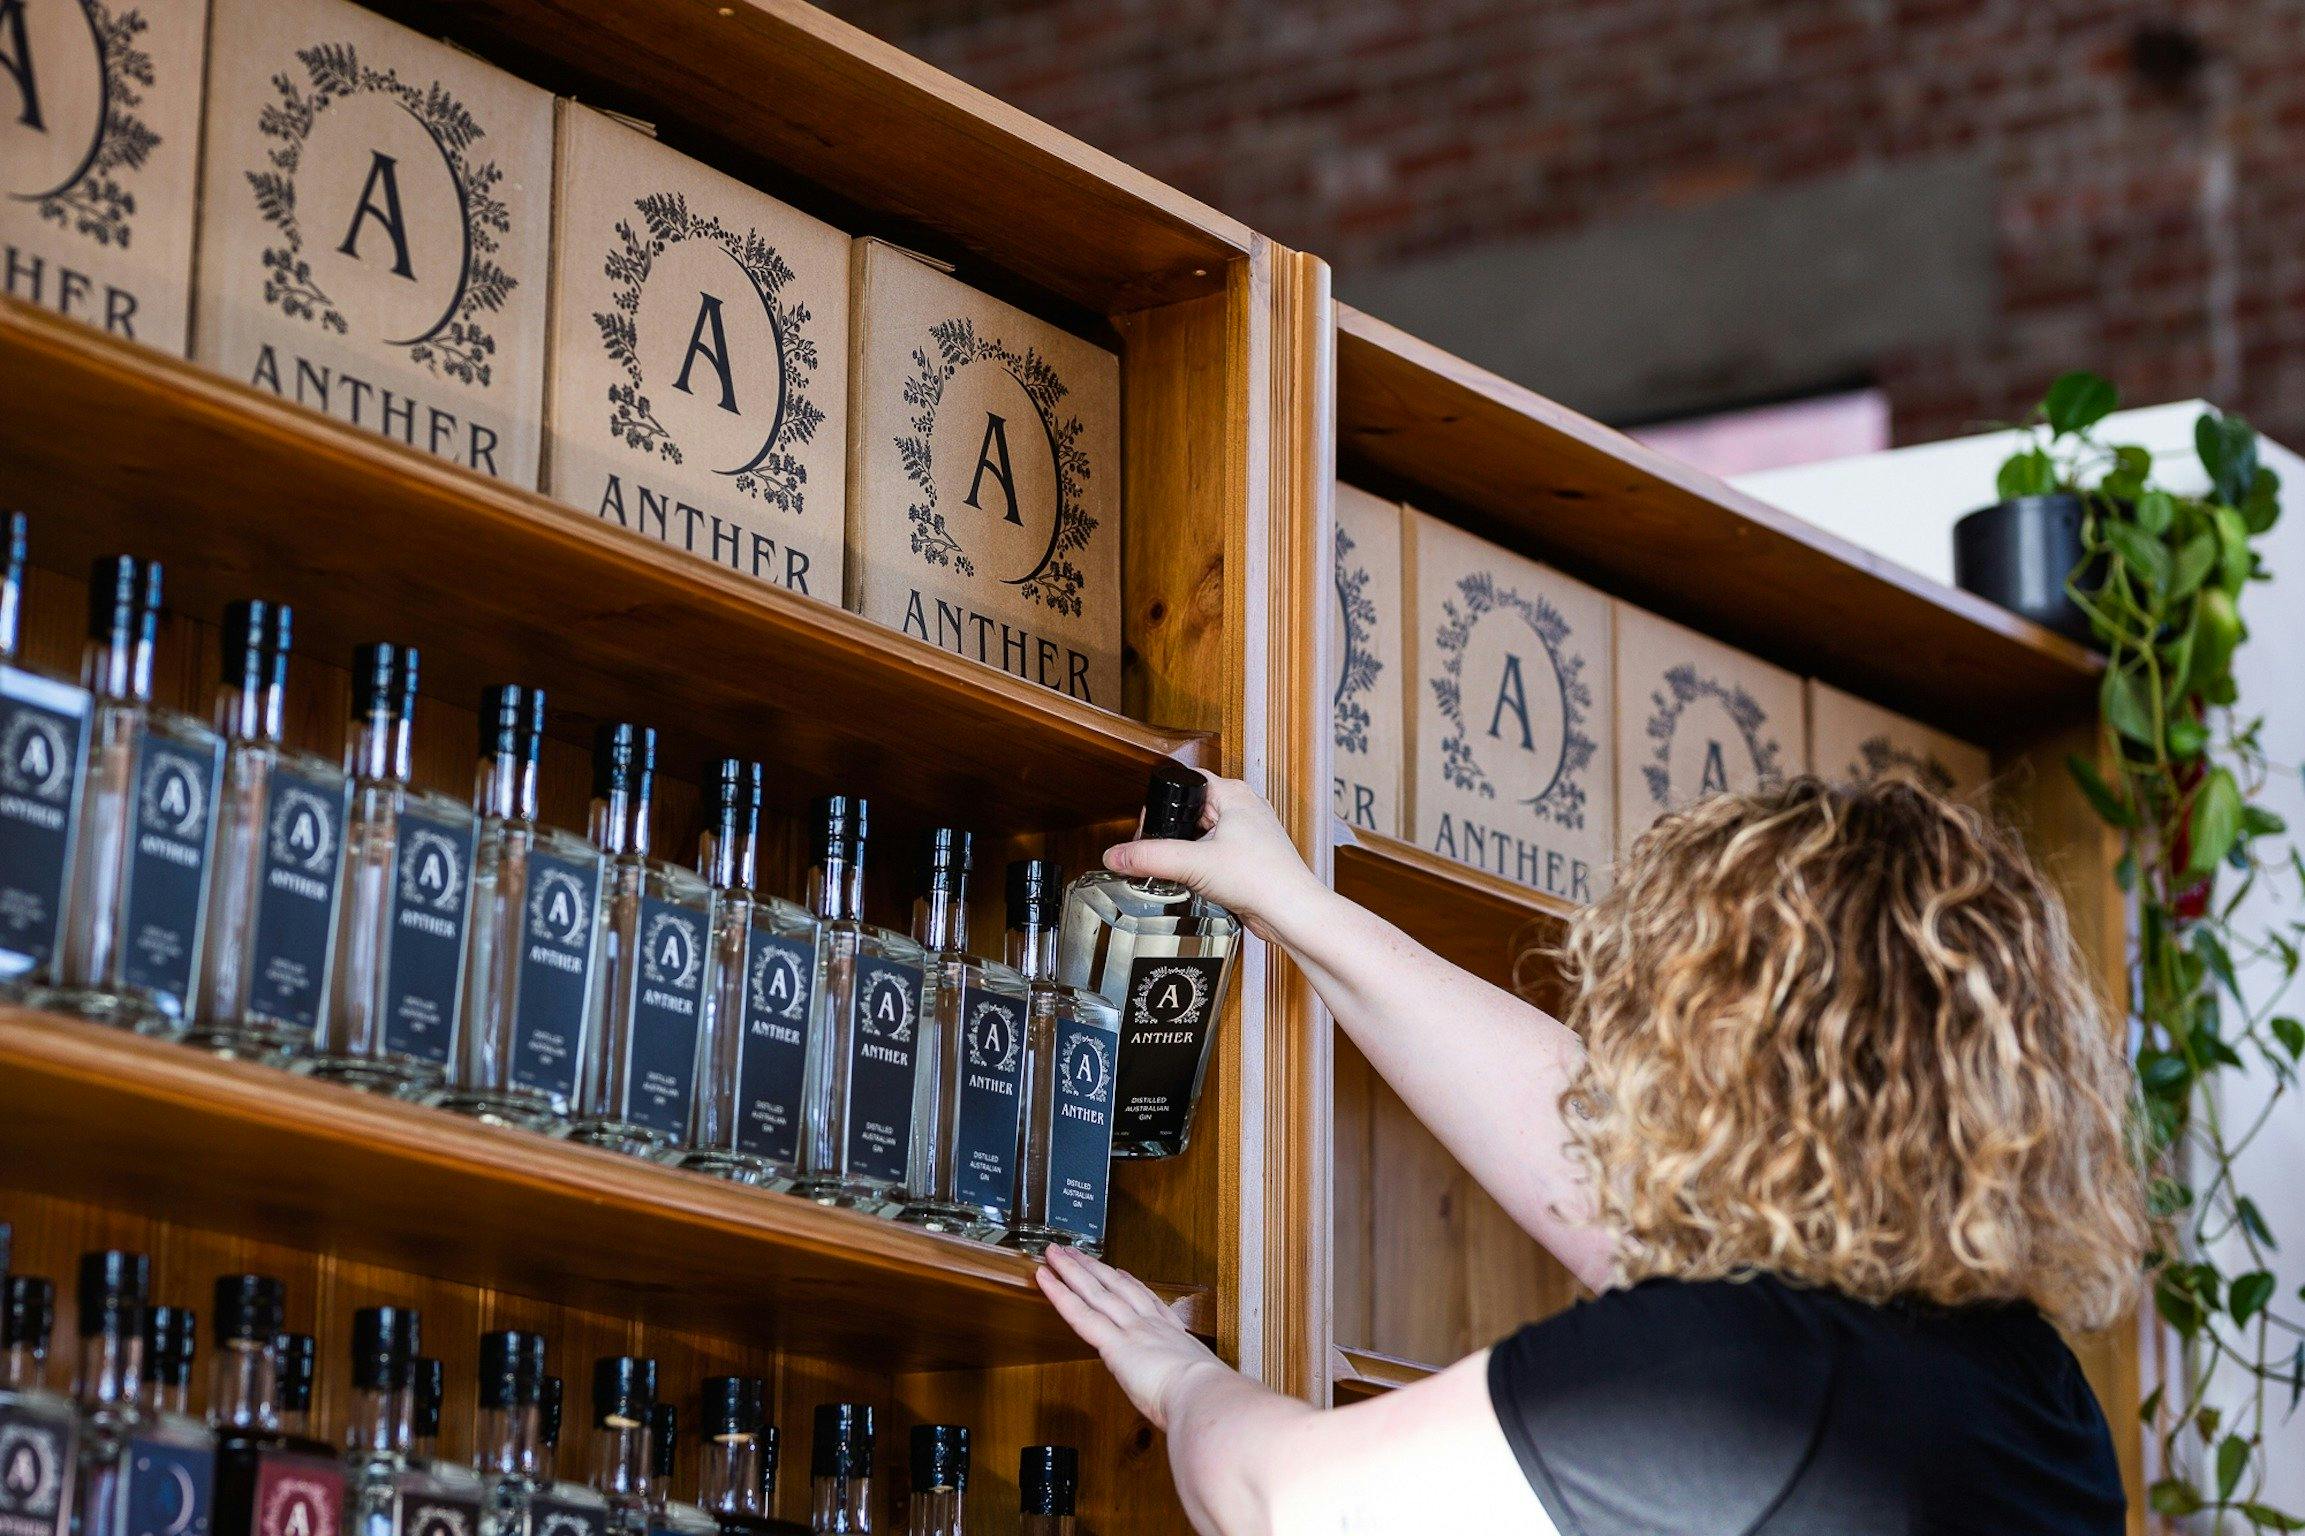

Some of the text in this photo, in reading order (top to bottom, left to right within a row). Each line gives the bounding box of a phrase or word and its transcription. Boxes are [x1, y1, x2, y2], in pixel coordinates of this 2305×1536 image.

[337, 149, 417, 282] A
[671, 291, 741, 416] A
[251, 344, 498, 477] ANTHER
[962, 411, 1025, 527] A
[599, 473, 810, 596] ANTHER
[902, 589, 1092, 705] ANTHER
[1488, 652, 1536, 751] A
[289, 811, 316, 850] A
[419, 853, 442, 890] A
[1434, 812, 1592, 904] ANTHER
[548, 891, 570, 926] A
[661, 935, 680, 969] A
[769, 968, 788, 1000] A
[1156, 984, 1180, 1009] A
[877, 991, 896, 1022] A
[750, 1020, 801, 1046] ANTHER
[984, 1023, 1001, 1052] A
[1130, 1031, 1194, 1044] ANTHER
[861, 1043, 909, 1067] ANTHER
[1075, 1053, 1093, 1082] A
[968, 1074, 1013, 1096] ANTHER
[1131, 1096, 1168, 1104] DISTILLED
[1060, 1103, 1105, 1126] ANTHER
[1062, 1188, 1094, 1202] AUSTRALIAN
[1066, 1178, 1092, 1191] DISTILLED
